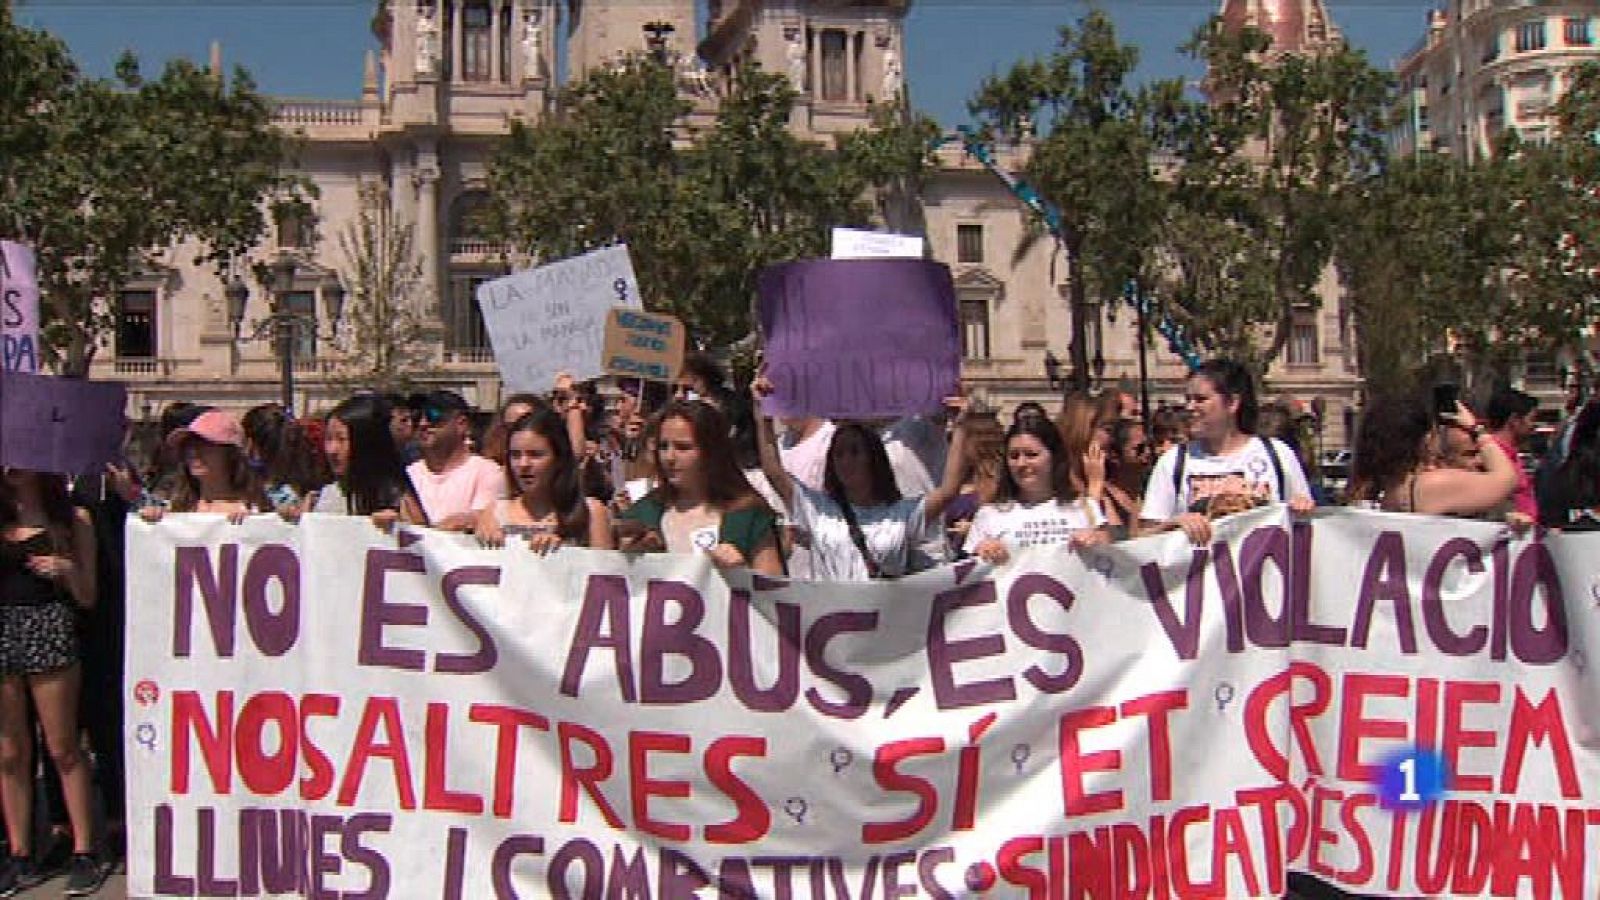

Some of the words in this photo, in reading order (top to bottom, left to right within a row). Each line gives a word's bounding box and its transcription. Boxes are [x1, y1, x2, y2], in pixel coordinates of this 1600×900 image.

[173, 543, 301, 657] NO
[358, 531, 502, 675] ÉS
[927, 560, 1084, 710] ÉS
[153, 803, 393, 900] LLIUES
[491, 834, 956, 900] COMBATIVES
[996, 783, 1284, 900] SINDICAT
[170, 690, 771, 844] NOSALTRES
[862, 712, 997, 844] SÍ
[1059, 687, 1188, 817] ET
[1244, 661, 1583, 799] CREIEM
